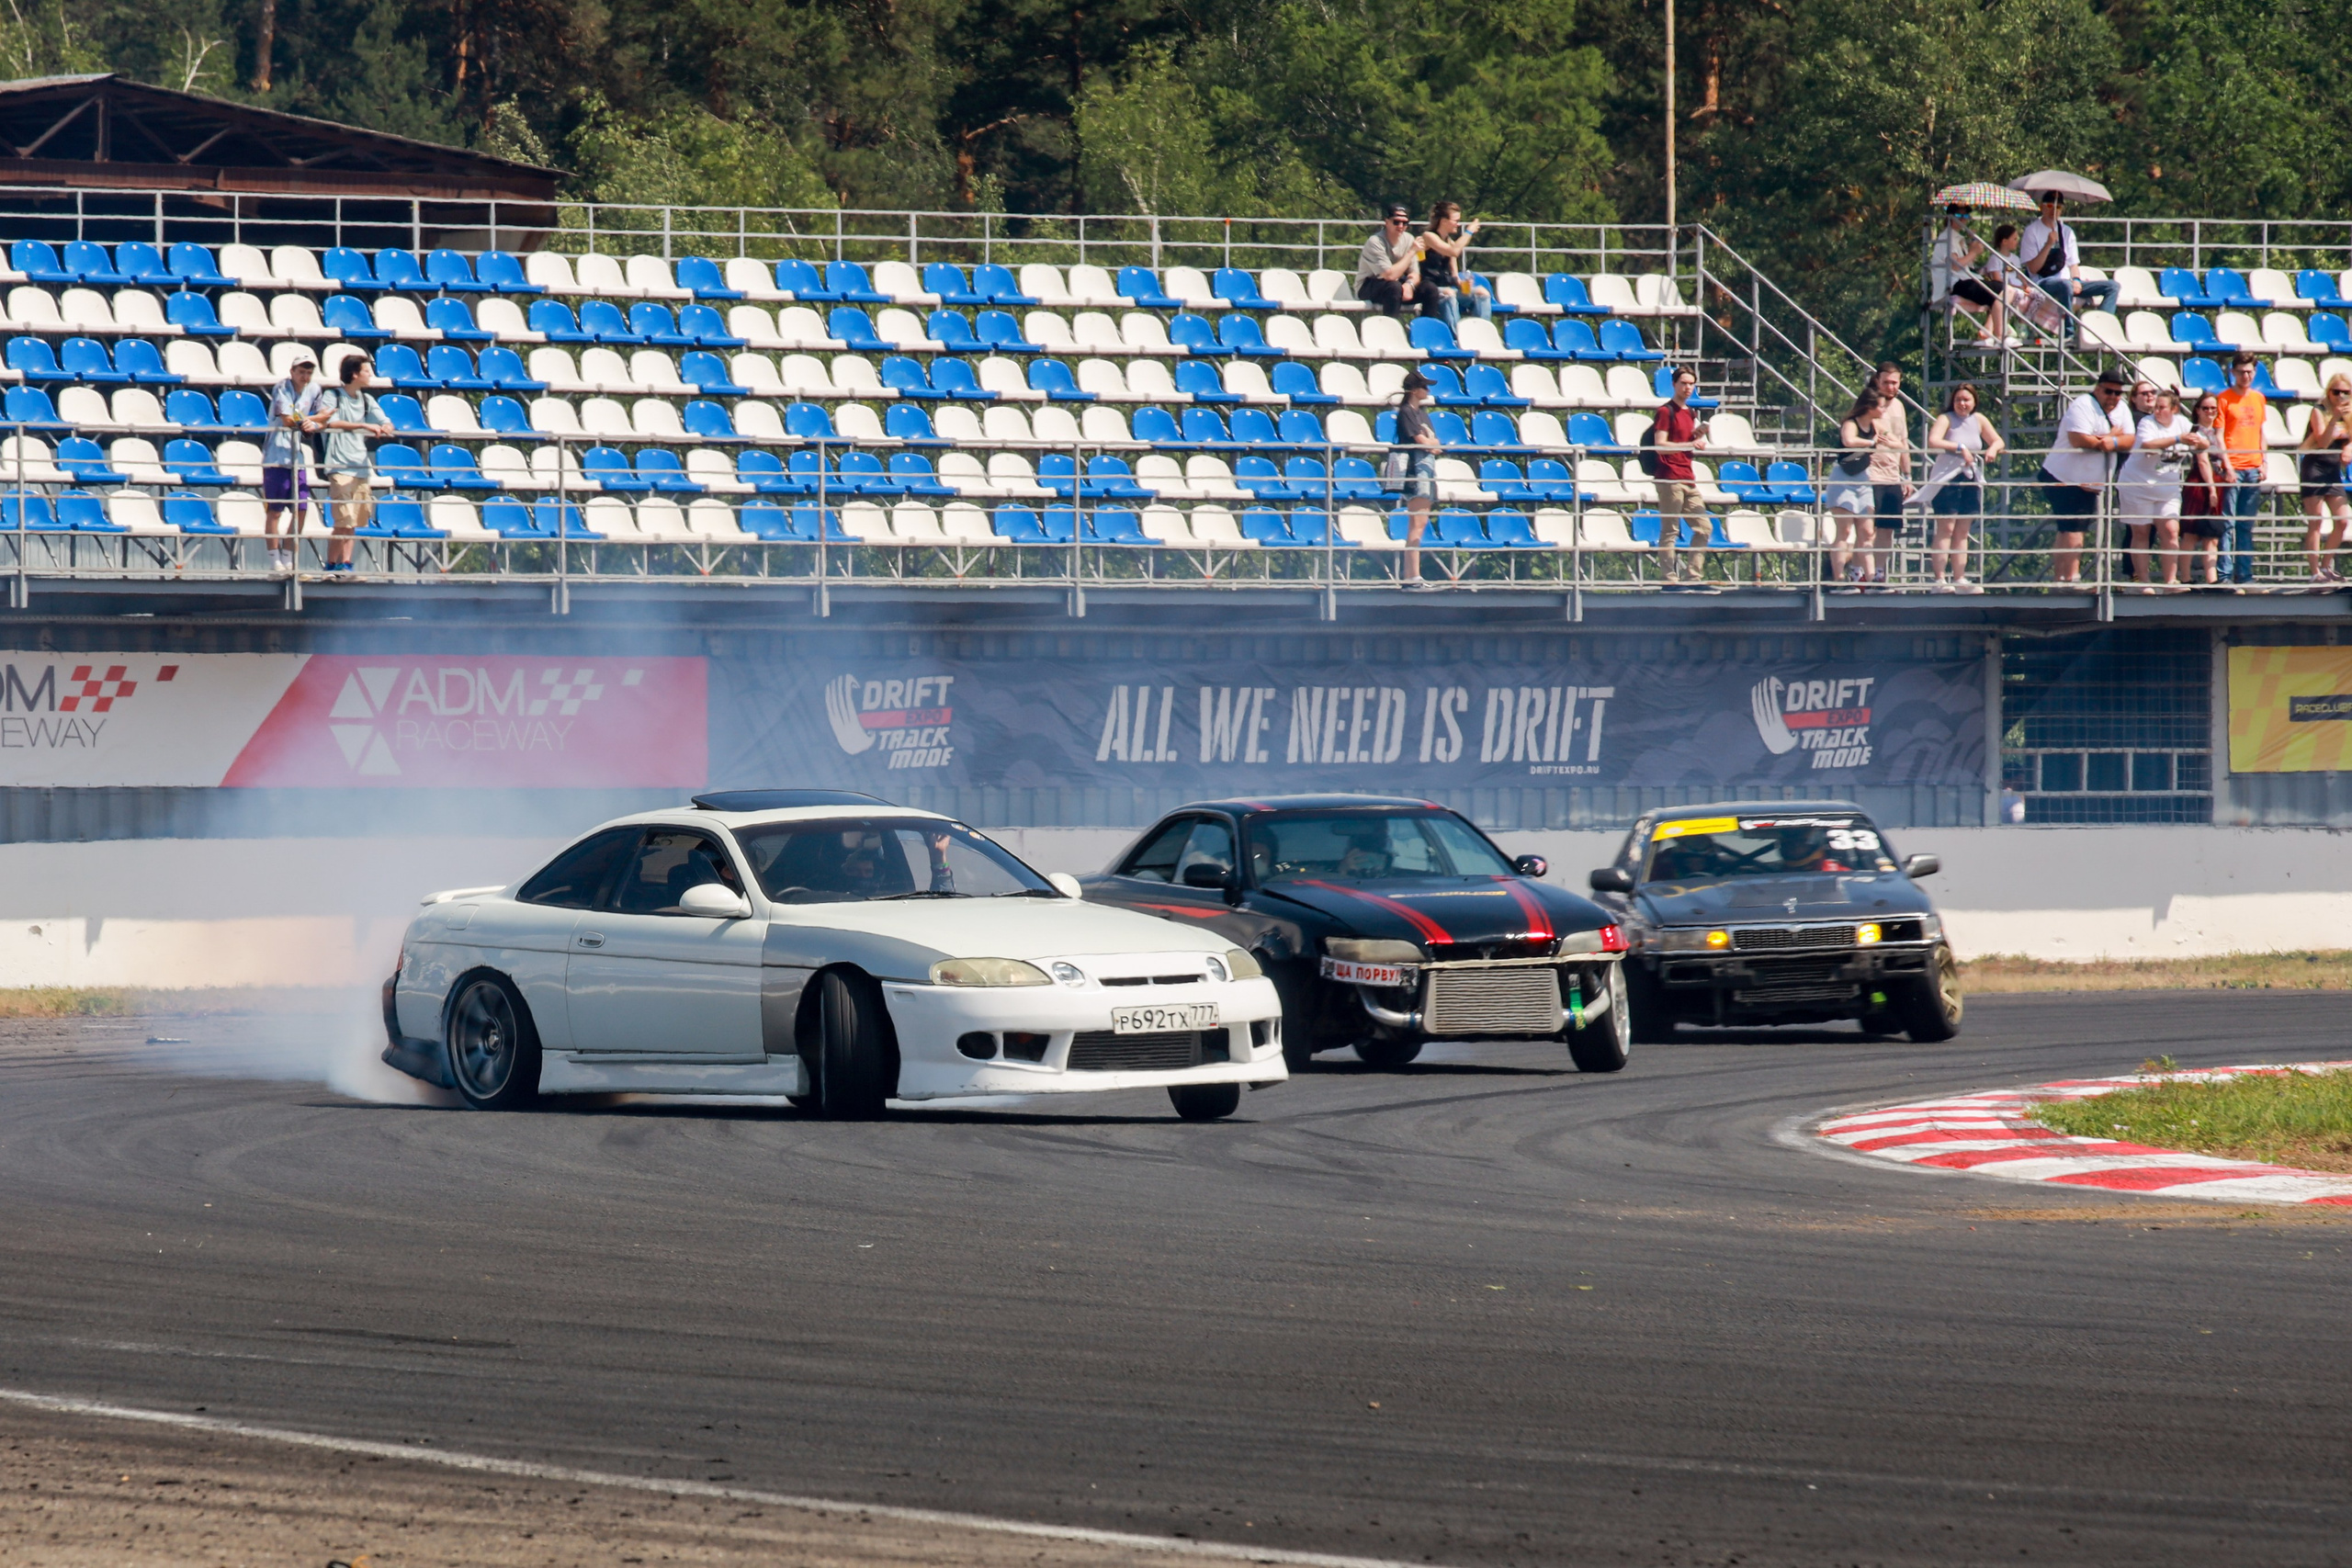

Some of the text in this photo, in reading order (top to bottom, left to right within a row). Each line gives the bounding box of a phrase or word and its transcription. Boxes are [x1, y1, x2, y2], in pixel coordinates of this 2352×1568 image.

[0, 663, 55, 712] M
[397, 667, 525, 716] ADM
[862, 675, 954, 710] DRIFT
[1786, 677, 1874, 712] DRIFT
[1095, 684, 1614, 764] ALL WE NEED IS DRIFT
[1827, 710, 1863, 724] EXPO
[1, 716, 107, 749] EWAY
[396, 719, 573, 751] RACEWAY
[878, 727, 950, 750] TRACK
[1801, 727, 1870, 750] TRACK
[888, 747, 955, 770] MODE
[1812, 746, 1873, 769] MODE
[1530, 765, 1600, 775] DRIFTEXPO.RU
[1826, 829, 1880, 851] 33
[1336, 963, 1399, 982] ЩА ПОРВУ!
[1191, 1005, 1214, 1021] 777
